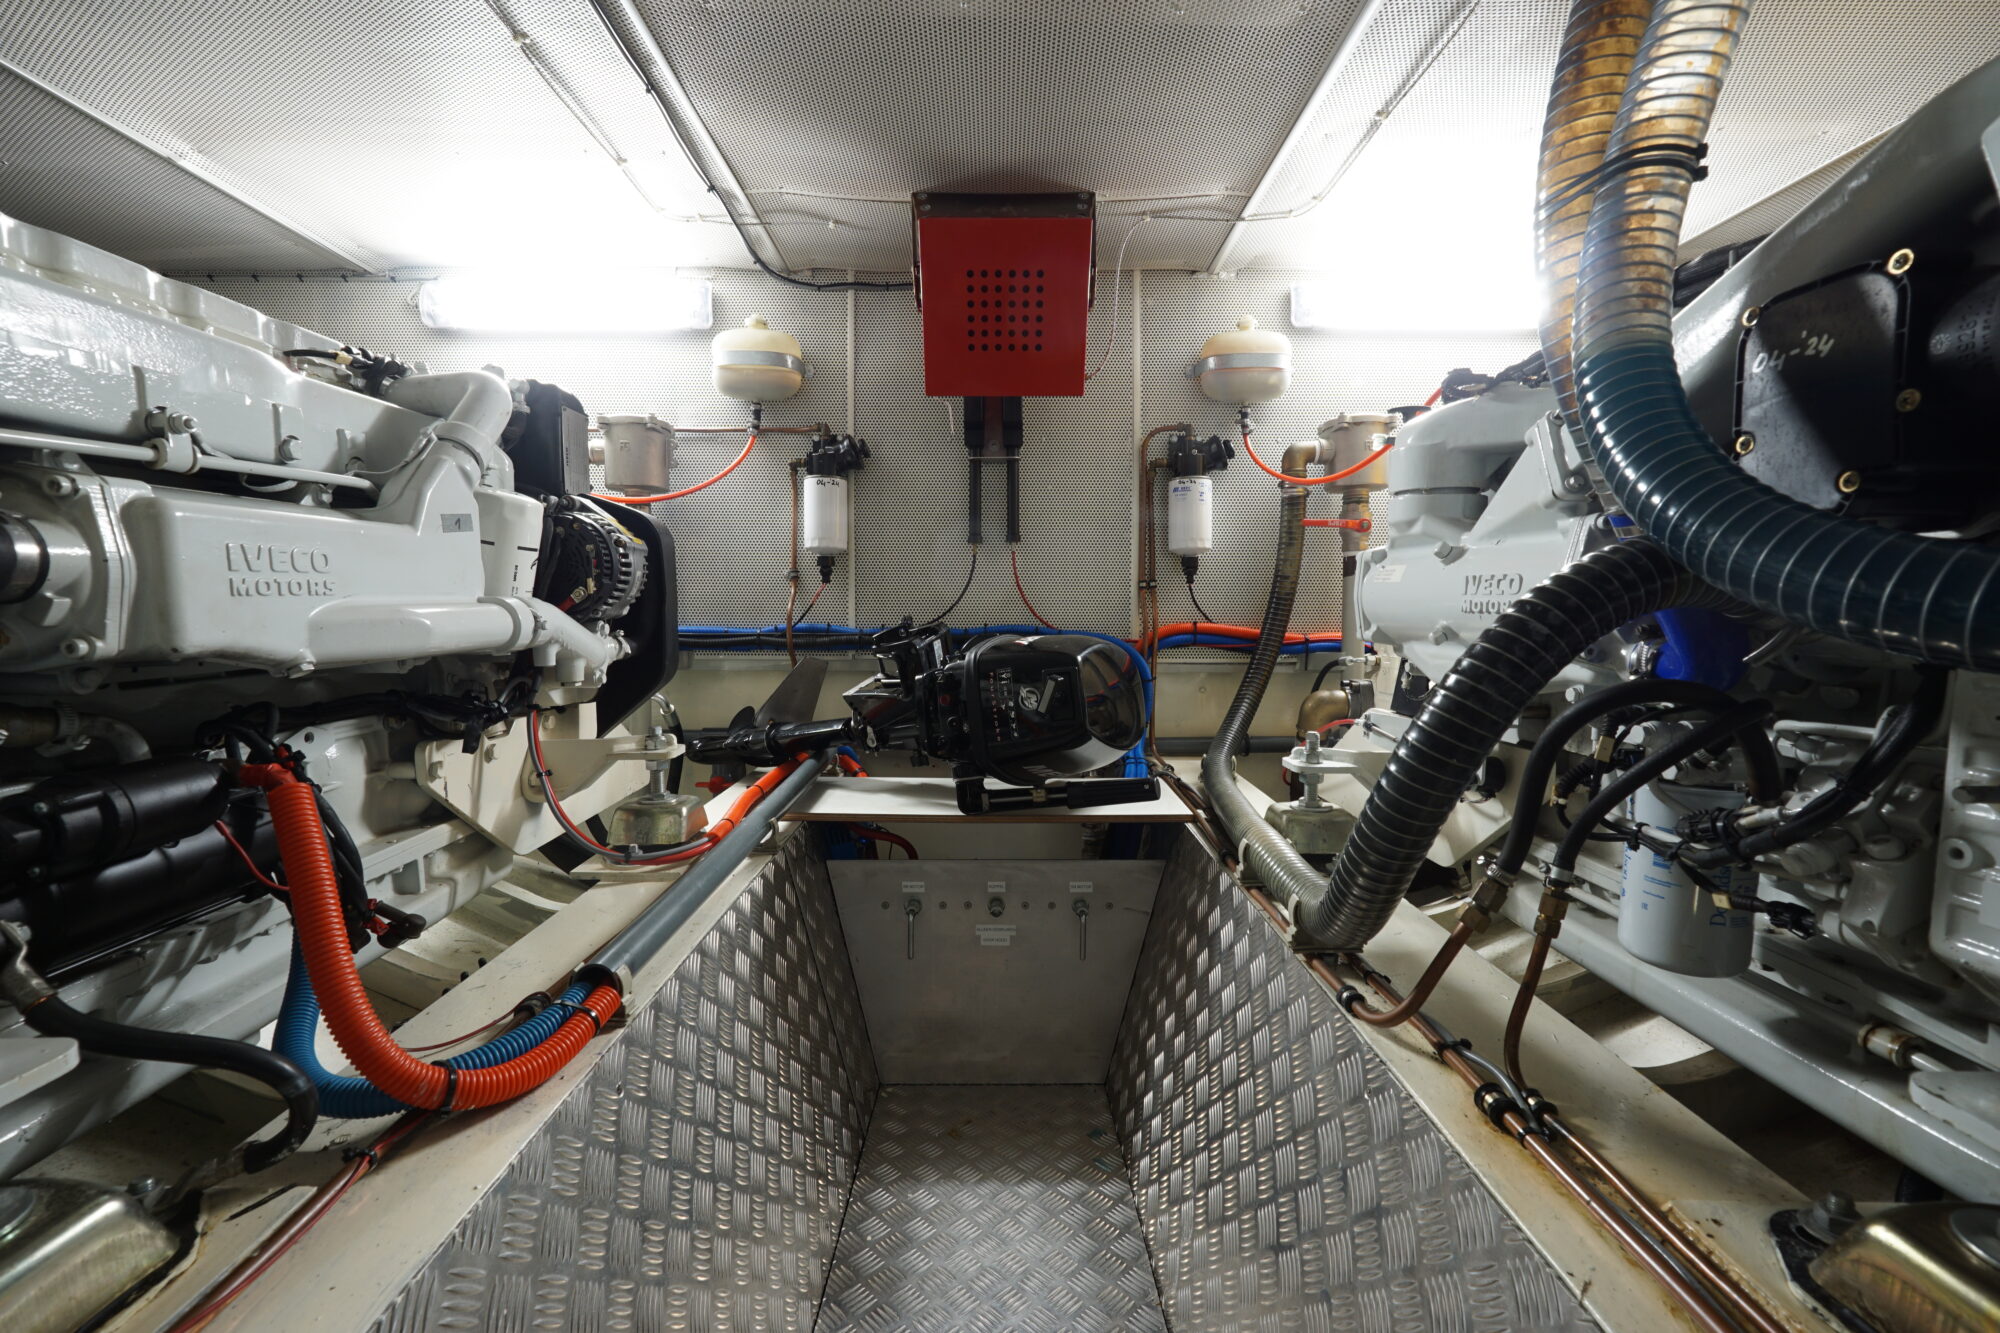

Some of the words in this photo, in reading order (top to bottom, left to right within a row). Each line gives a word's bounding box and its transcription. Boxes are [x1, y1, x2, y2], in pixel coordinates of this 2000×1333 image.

[225, 542, 331, 574] IVECO
[229, 577, 336, 597] MOTORS
[1462, 573, 1523, 596] IVECO
[1461, 599, 1512, 615] MOTOR
